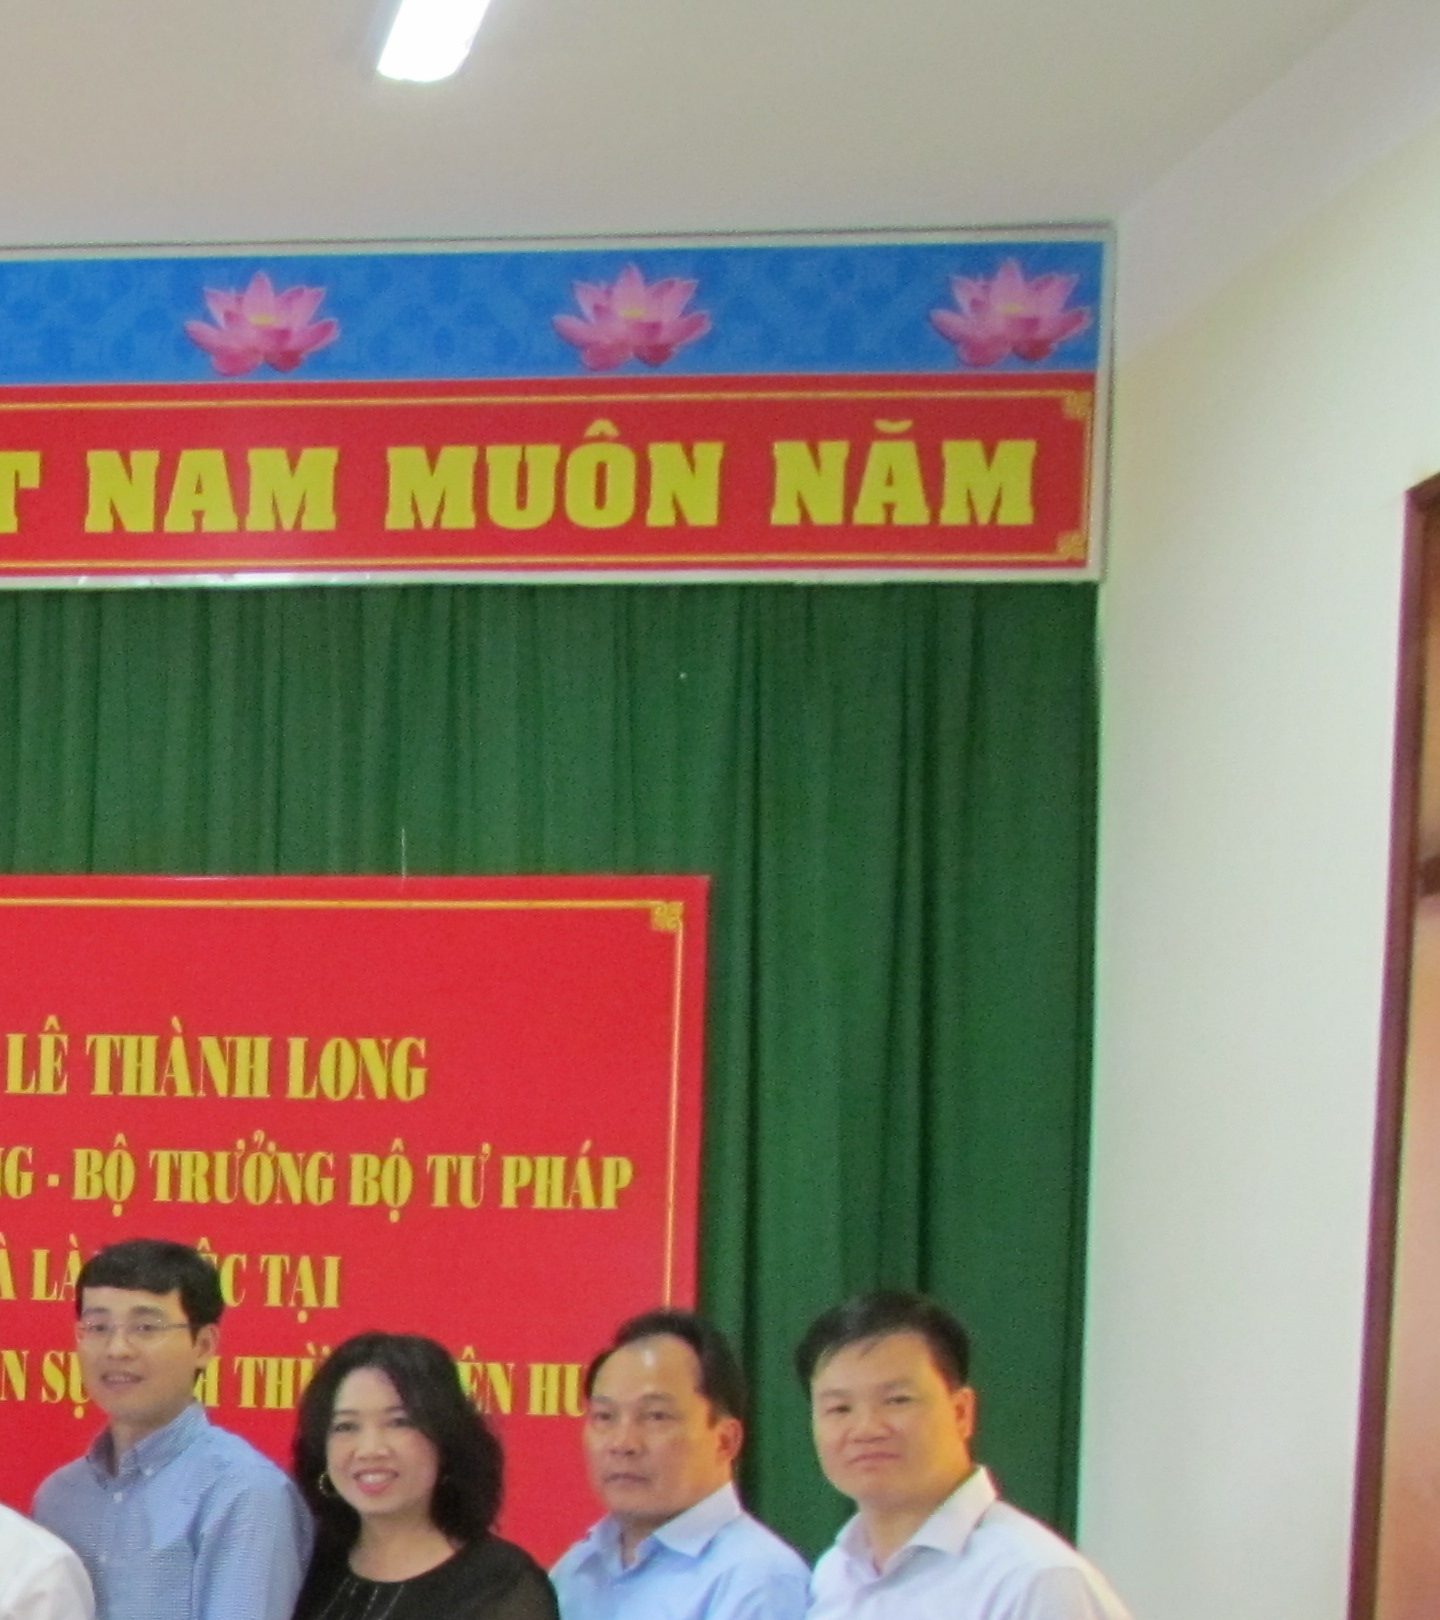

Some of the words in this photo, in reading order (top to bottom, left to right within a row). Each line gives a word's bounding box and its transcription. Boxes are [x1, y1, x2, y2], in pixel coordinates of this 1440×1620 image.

[85, 448, 338, 532] NAM
[385, 420, 722, 529] MUÔN
[771, 421, 1035, 525] NĂM
[7, 1016, 68, 1094] LÊ
[86, 1018, 271, 1097] THÀNH
[288, 1038, 426, 1101] LONG
[74, 1134, 135, 1216] BỘ
[150, 1132, 334, 1205] TRƯỞNG
[350, 1139, 412, 1221] BỘ
[427, 1144, 490, 1208] TƯ
[502, 1143, 632, 1209] PHÁP
[31, 1233, 82, 1301] LÀ
[261, 1255, 339, 1322] TẠI
[526, 1363, 587, 1417] HU
